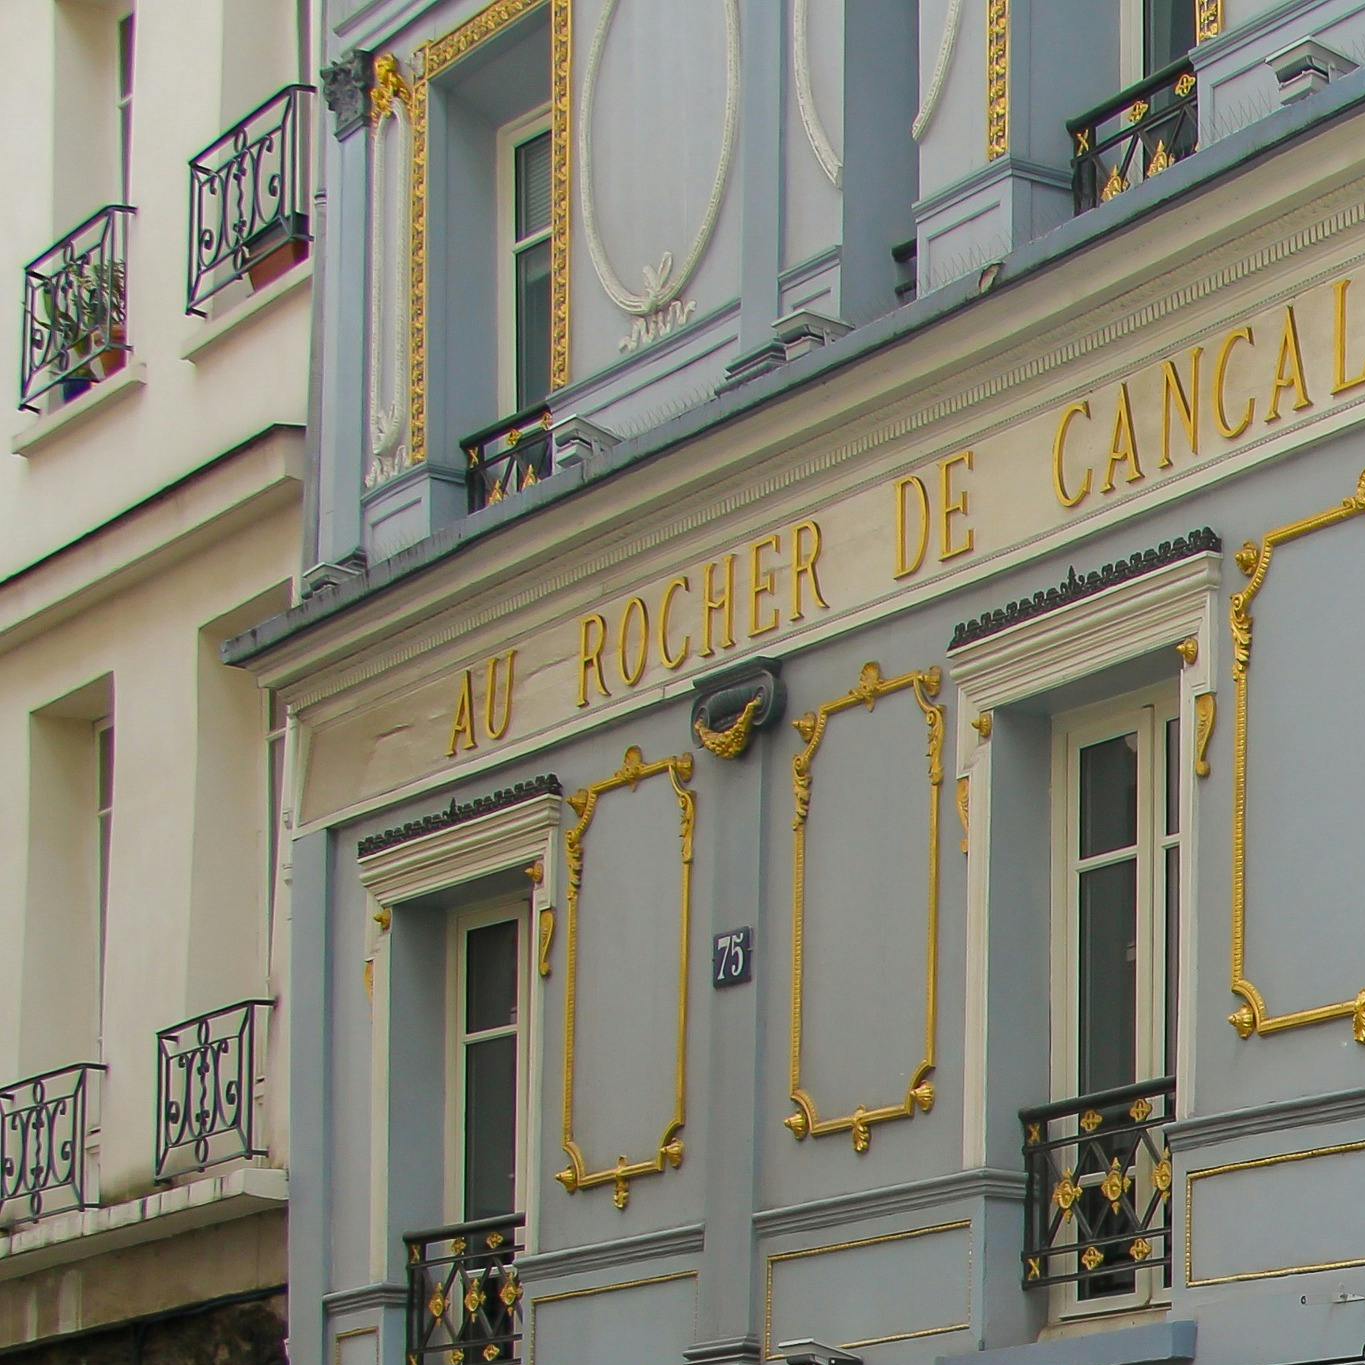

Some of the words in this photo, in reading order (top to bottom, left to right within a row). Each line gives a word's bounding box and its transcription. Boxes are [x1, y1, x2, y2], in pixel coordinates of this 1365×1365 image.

[444, 650, 516, 758] AU
[576, 520, 829, 709] ROCHER
[893, 451, 974, 580] DE
[717, 932, 744, 980] 75
